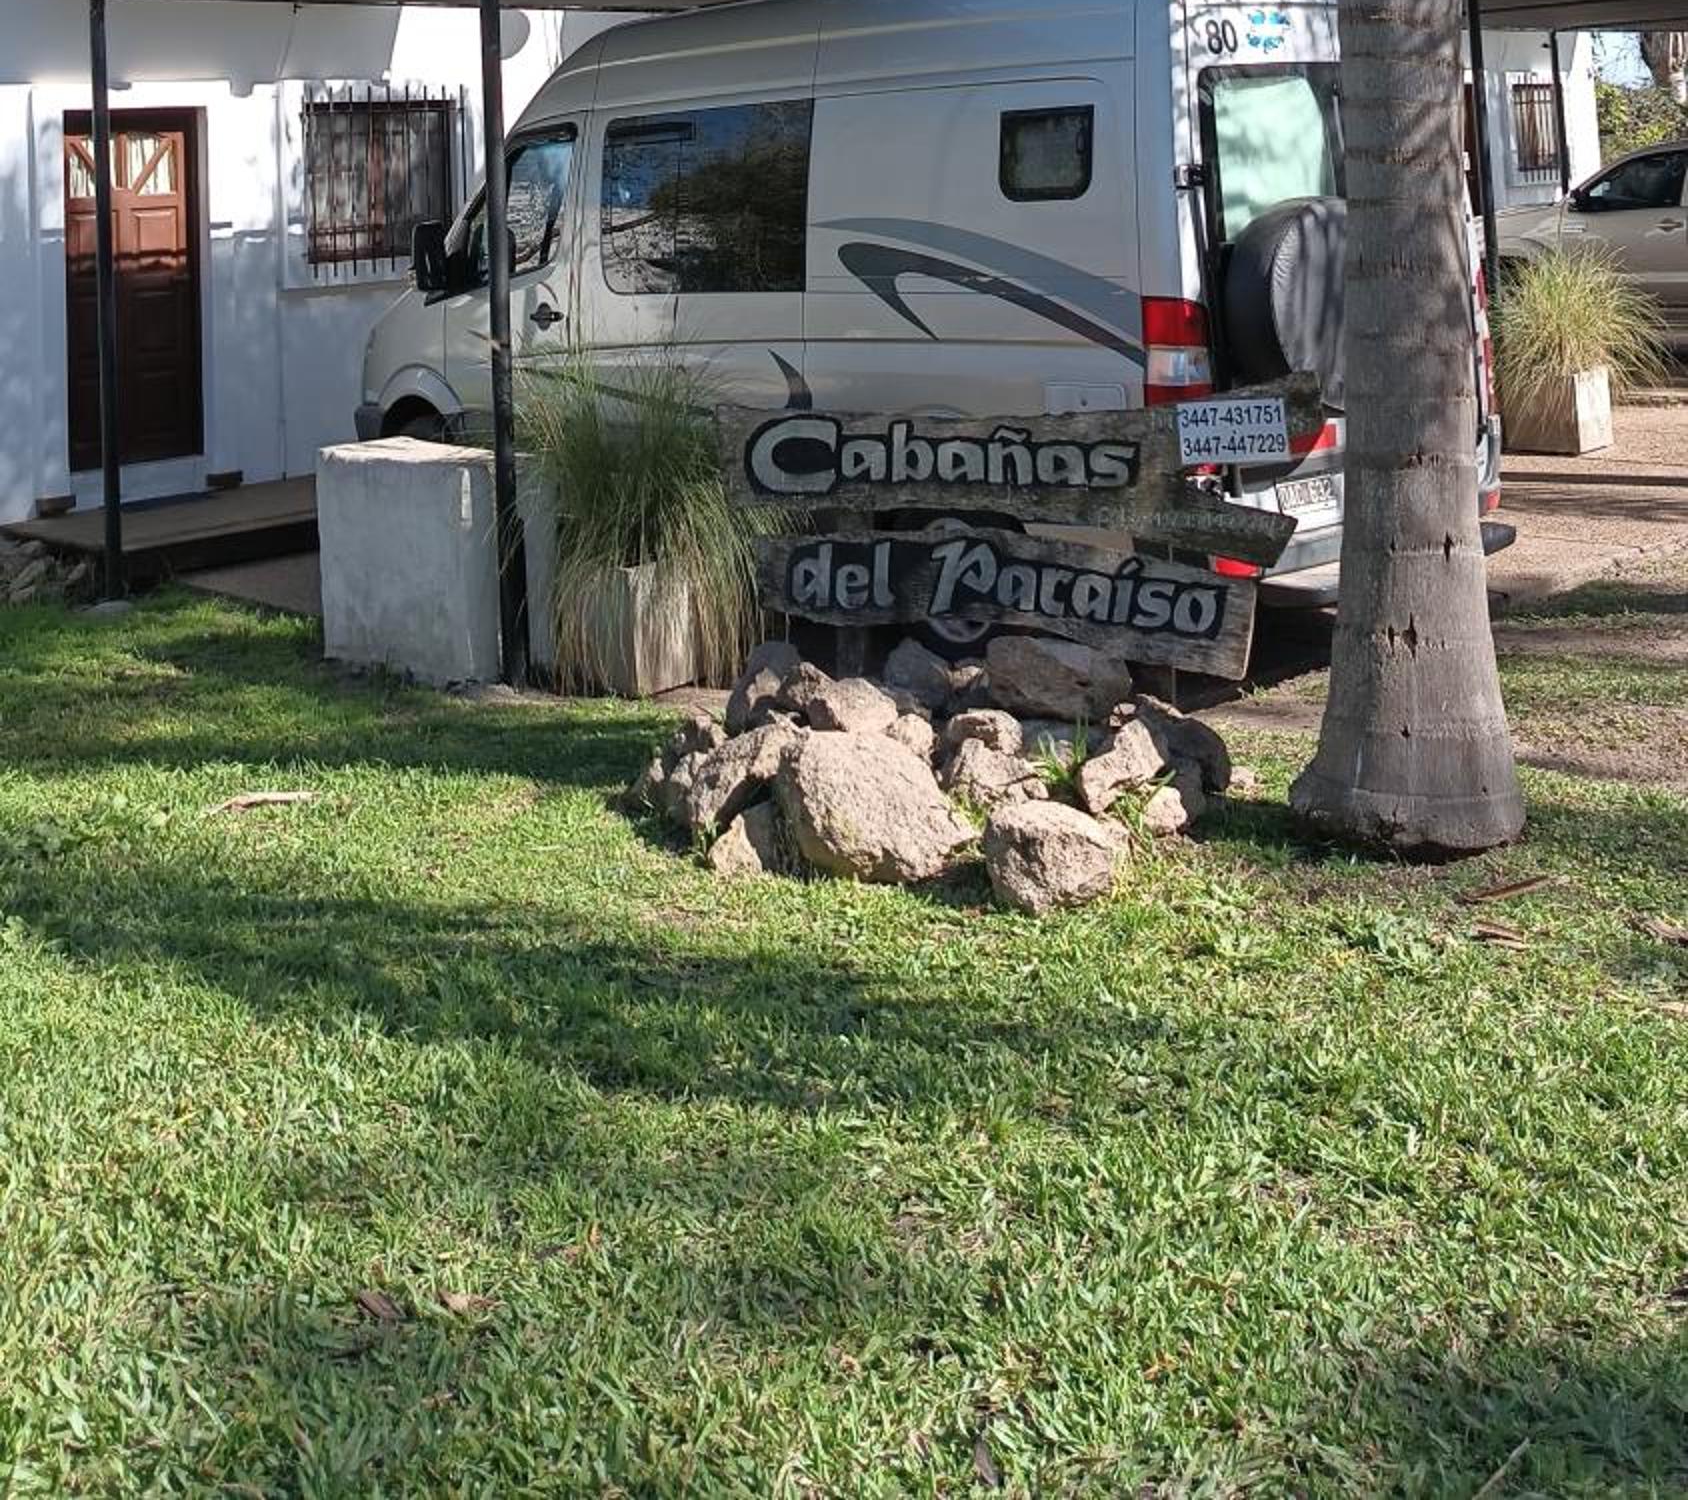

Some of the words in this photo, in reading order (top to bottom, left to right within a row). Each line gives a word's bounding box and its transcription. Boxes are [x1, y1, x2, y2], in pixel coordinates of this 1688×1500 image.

[1205, 19, 1238, 54] 80
[1181, 405, 1282, 428] 3447-431751
[752, 419, 1137, 492] Cabañas
[1183, 433, 1286, 457] 3447-447229
[791, 543, 893, 607] del
[932, 540, 1222, 632] Paraíso
